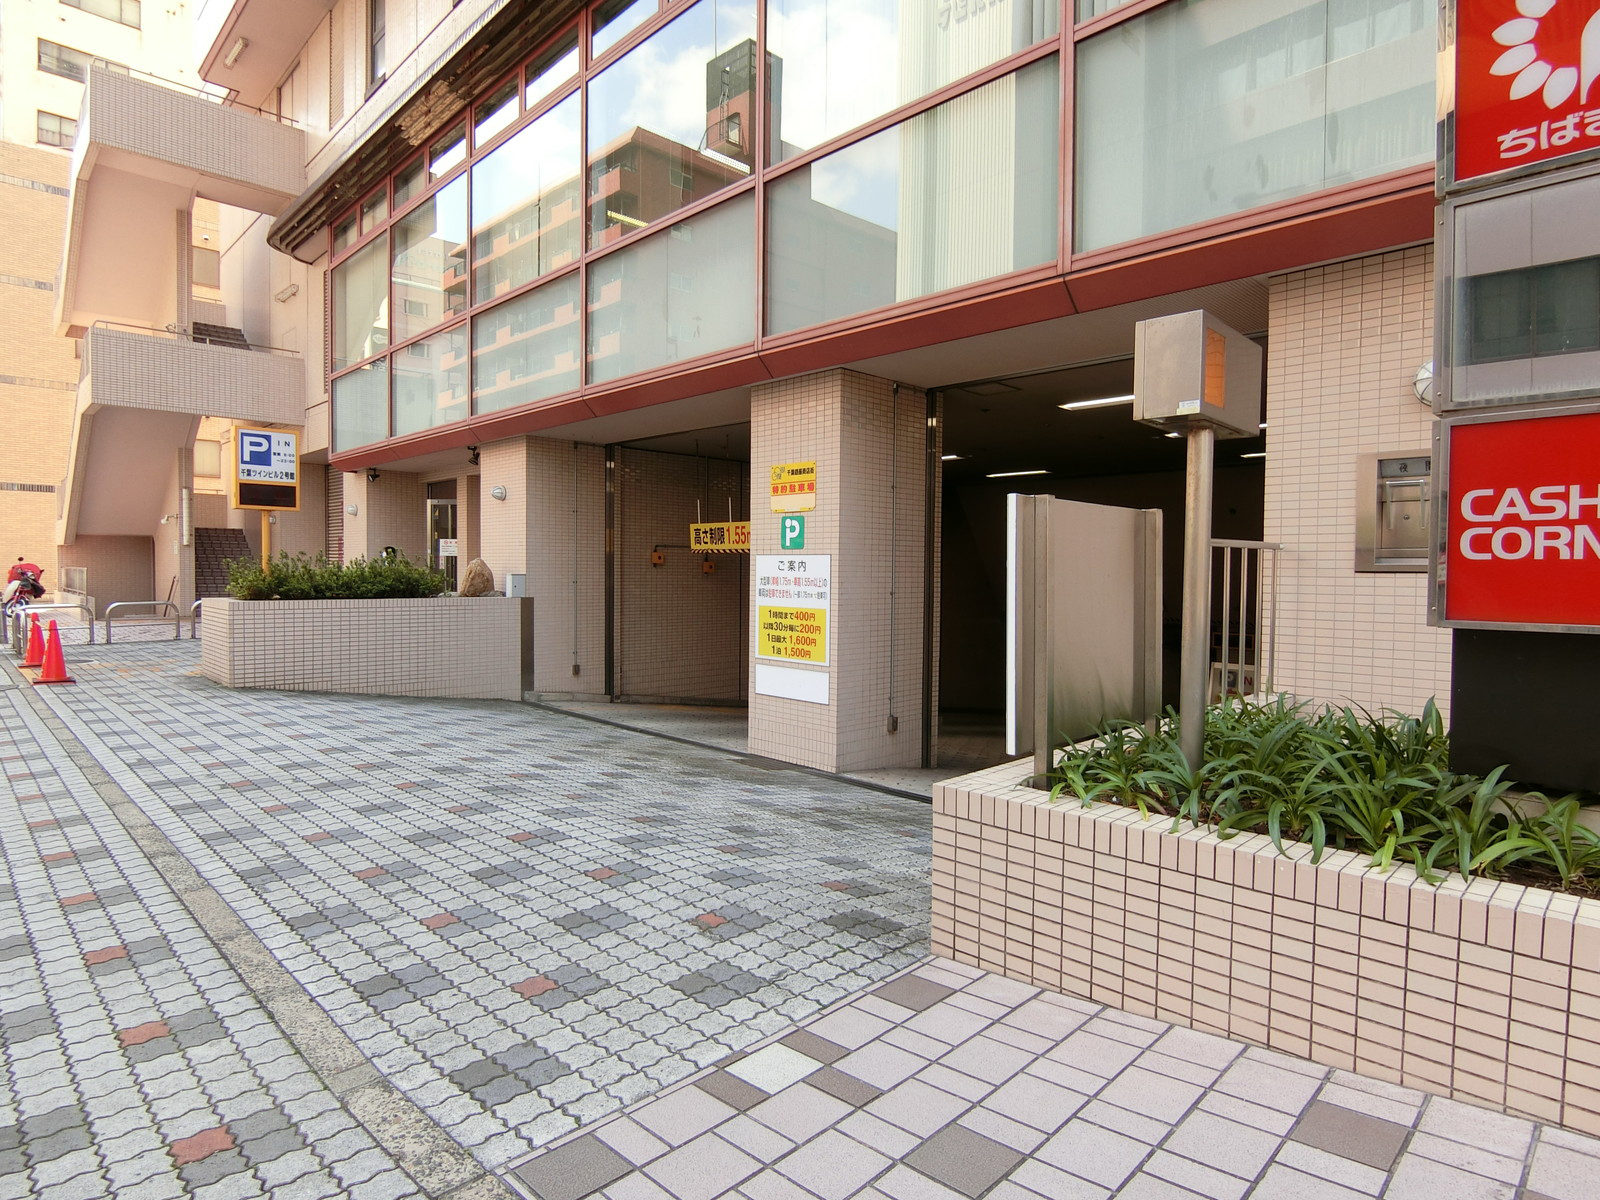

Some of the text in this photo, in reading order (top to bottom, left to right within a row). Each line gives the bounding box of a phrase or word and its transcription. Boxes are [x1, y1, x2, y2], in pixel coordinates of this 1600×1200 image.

[242, 435, 270, 462] P
[1460, 484, 1600, 522] CASH
[777, 560, 807, 572] ご案内
[768, 609, 816, 622] 1時間まで400円
[789, 634, 817, 647] 1,600円
[771, 645, 811, 659] 1泊 1,500円
